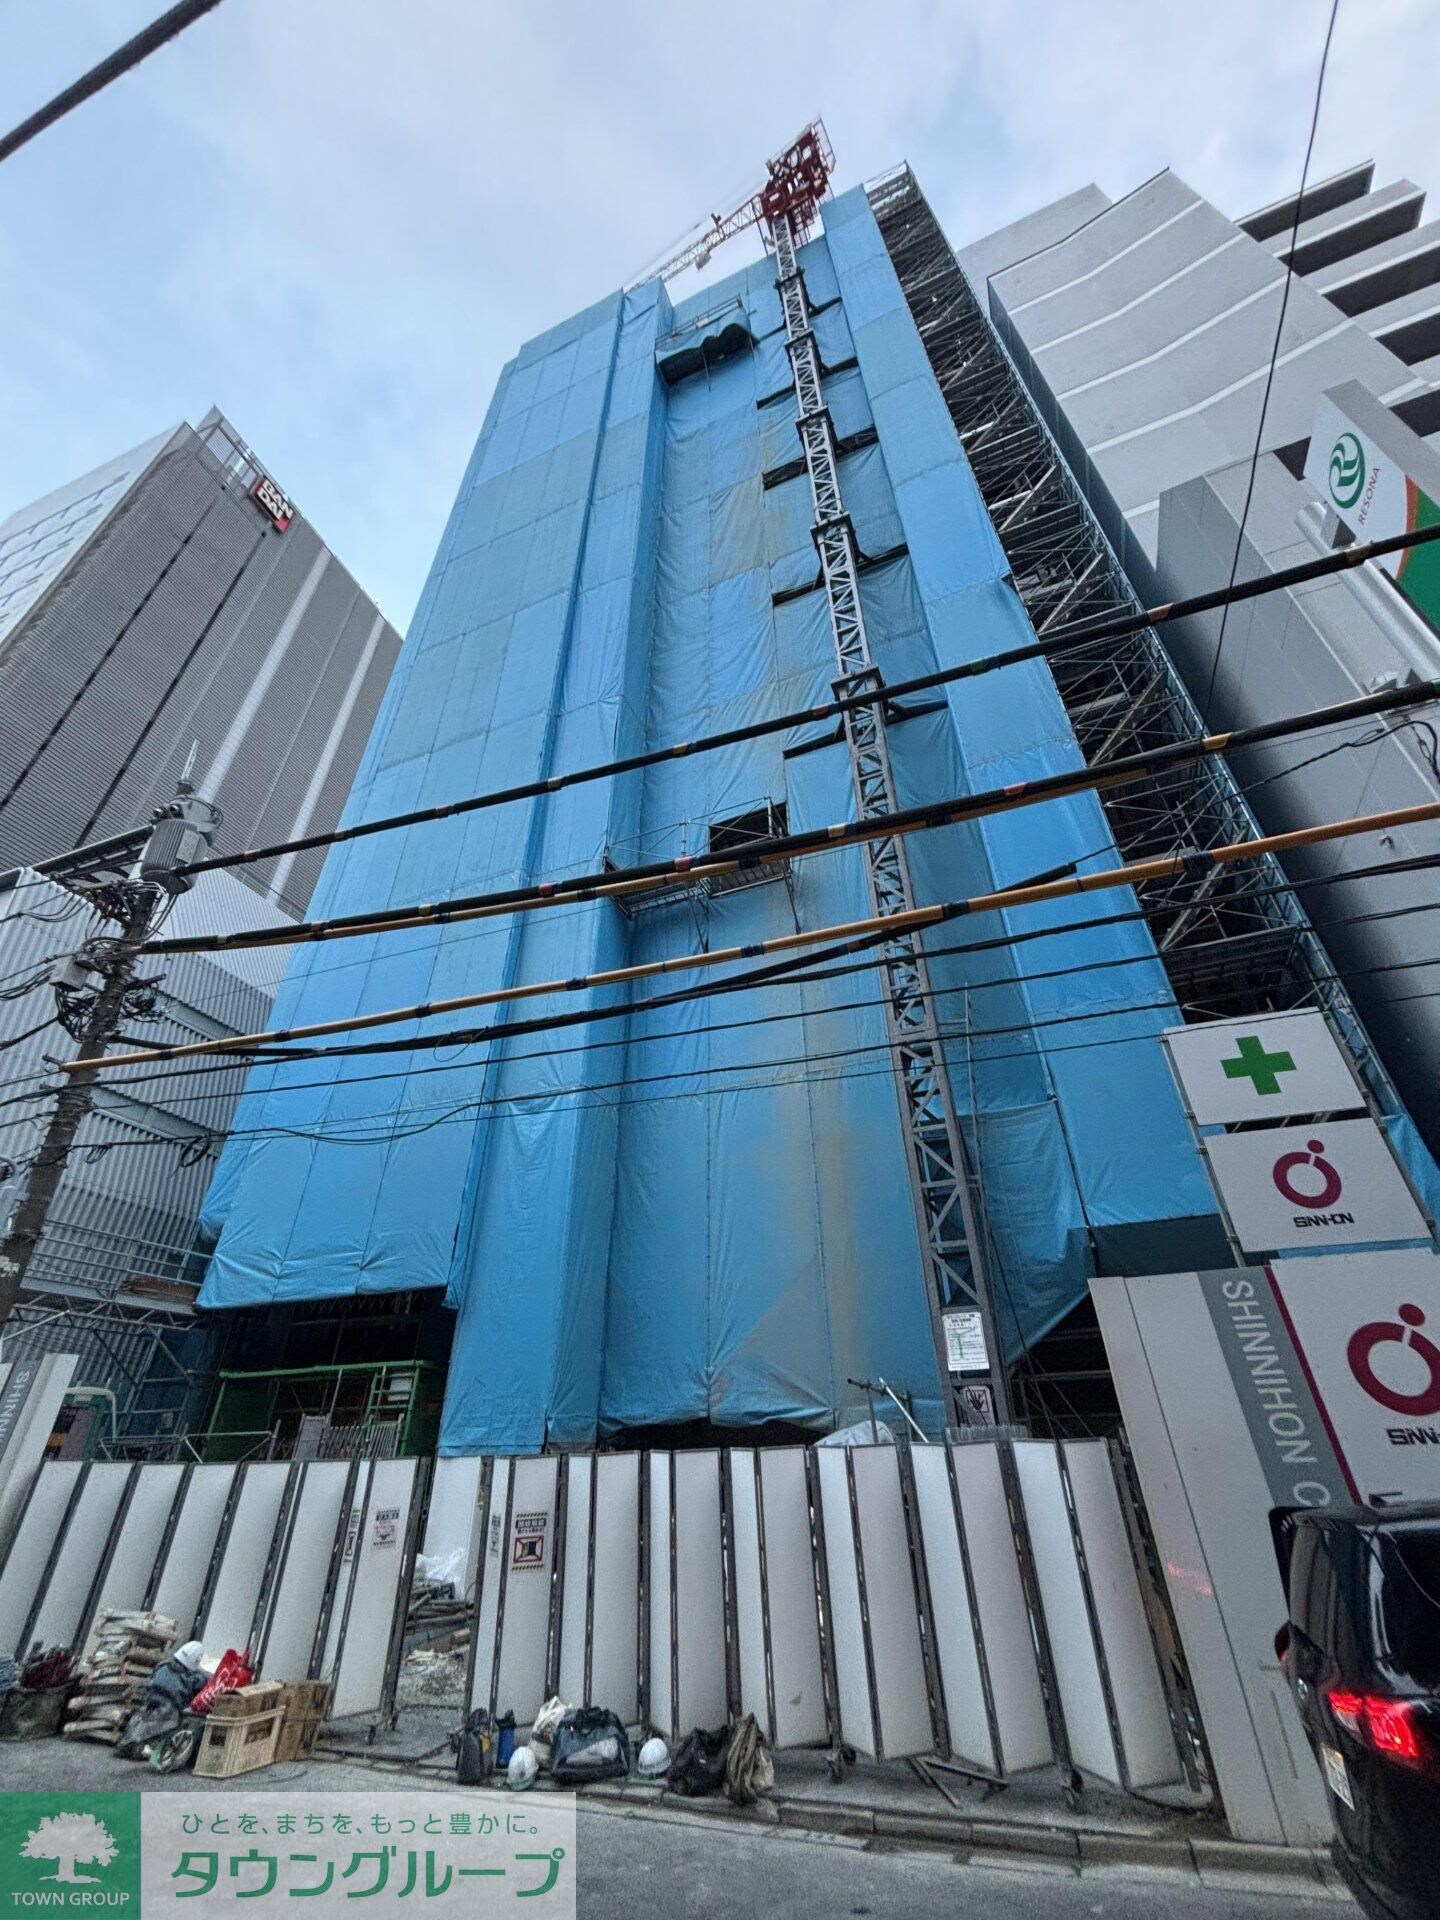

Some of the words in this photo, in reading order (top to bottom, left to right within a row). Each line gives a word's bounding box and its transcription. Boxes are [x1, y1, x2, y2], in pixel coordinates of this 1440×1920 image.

[258, 487, 284, 520] DAI
[263, 480, 294, 520] BAN
[1358, 467, 1380, 525] RESONA
[1222, 1280, 1318, 1464] SHINNIHON
